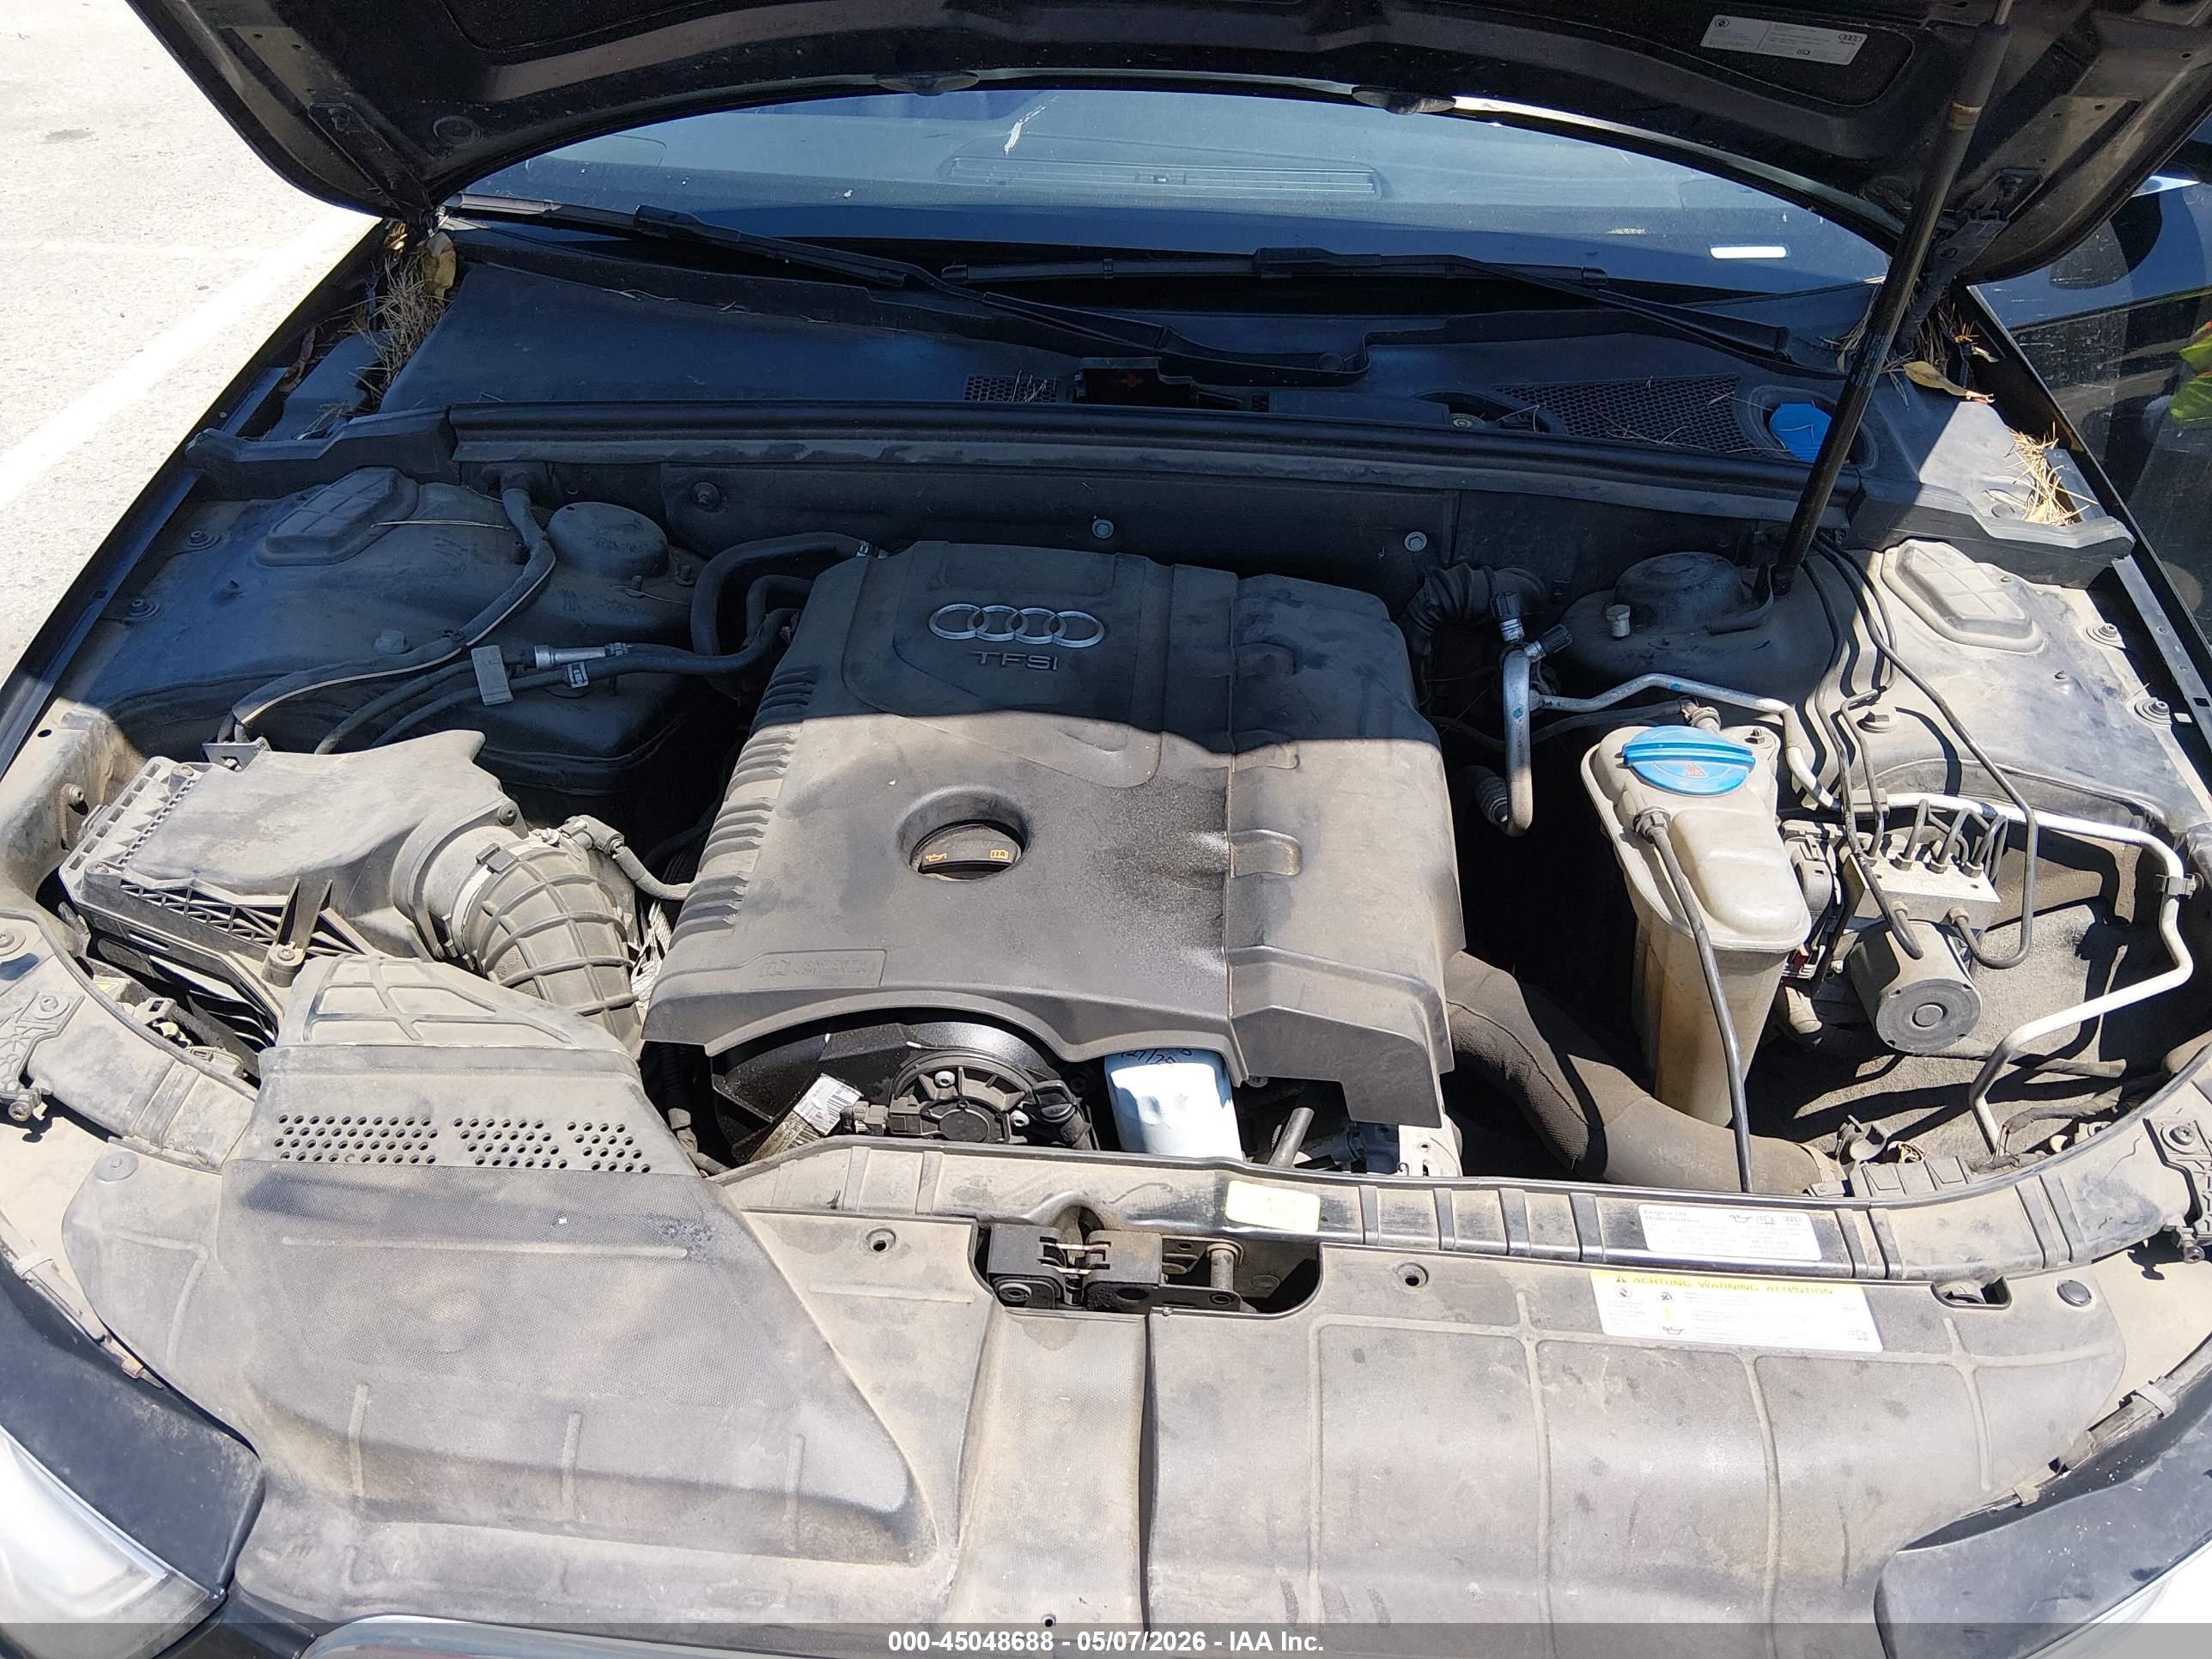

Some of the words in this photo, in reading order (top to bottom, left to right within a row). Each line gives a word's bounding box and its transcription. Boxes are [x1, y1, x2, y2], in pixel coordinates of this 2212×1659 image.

[970, 651, 1059, 672] TFSI
[1632, 1277, 1692, 1288] ACHTUNG
[1698, 1279, 1759, 1291] WARNING
